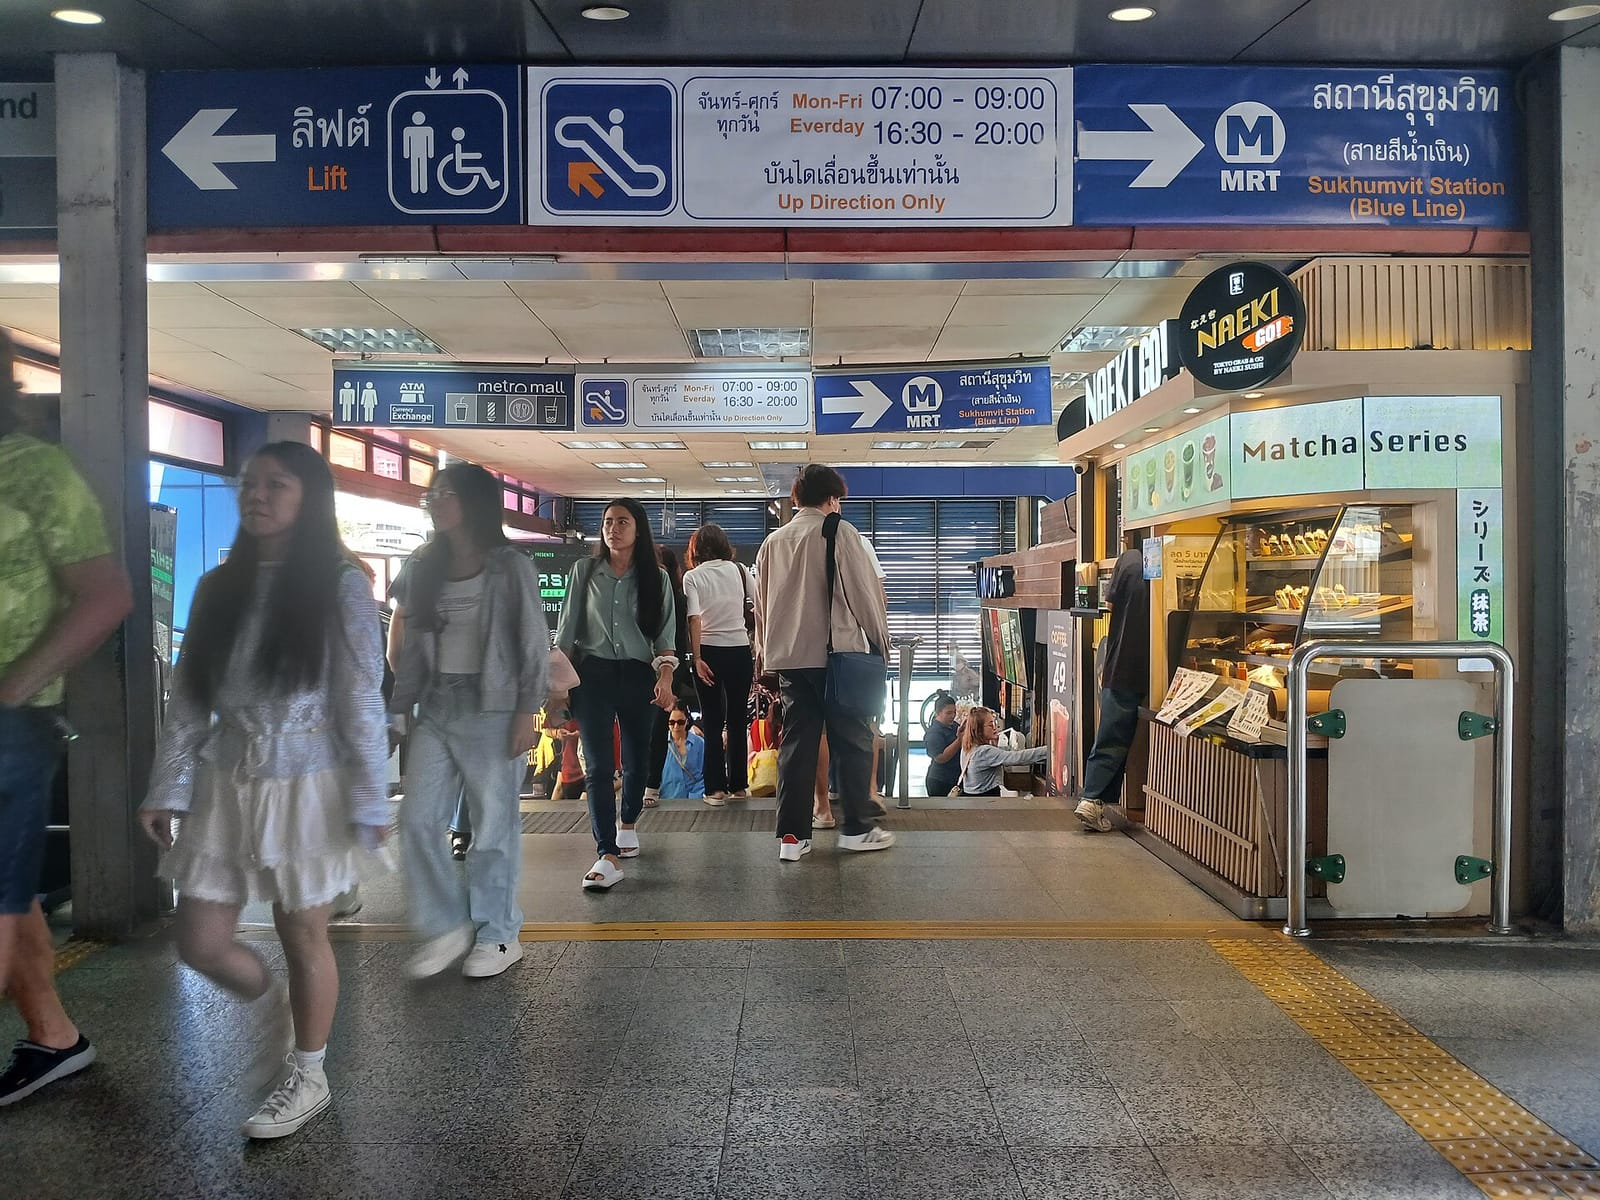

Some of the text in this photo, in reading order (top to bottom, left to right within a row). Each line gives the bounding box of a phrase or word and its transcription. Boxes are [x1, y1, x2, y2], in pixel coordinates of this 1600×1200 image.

[698, 91, 779, 114] จันทร์-ศุกร์
[792, 93, 863, 109] Mon-Fri
[871, 86, 942, 111] 07:00
[974, 86, 1045, 111] 09:00
[1313, 74, 1499, 126] สถานีสุขุมวิท
[292, 103, 372, 148] ลิฟต์
[716, 115, 760, 139] ทุกวัน
[790, 119, 865, 136] Everday
[873, 121, 942, 145] 16:30
[974, 121, 1045, 145] 20:00
[1343, 131, 1470, 167] (สายสีน้ำเงิน)
[308, 166, 348, 191] Lift
[764, 154, 960, 185] บันไดเลื่อนขึ้นเท่านั้น
[1221, 170, 1281, 191] MRT
[1308, 176, 1505, 196] Sukhumvit Station
[778, 194, 946, 212] Up Direction Only
[1350, 199, 1466, 221] (Blue Line)
[1197, 287, 1280, 357] NAEKI
[1255, 320, 1282, 348] GO!
[1085, 319, 1168, 428] NAEKI GO!
[1213, 361, 1232, 369] TOKYO
[1224, 365, 1243, 373] NAEKI
[1244, 362, 1264, 370] SUSHI
[400, 382, 425, 391] ATM
[477, 380, 565, 393] metro mall
[683, 384, 715, 392] Mon-Fri
[722, 381, 753, 392] 07:00
[766, 381, 798, 392] 09:00
[960, 371, 1032, 391] สถานีสุขุมวิท
[683, 395, 716, 405] Everday
[723, 396, 753, 407] 16:30
[766, 396, 798, 407] 20:00
[392, 412, 432, 422] Exchange
[723, 414, 783, 423] Up Direction Only
[906, 414, 940, 428] MRT
[959, 408, 1035, 418] Sukhumvit Station
[974, 417, 1020, 426] (Blue Line)
[1243, 430, 1467, 463] Matcha Series
[1471, 500, 1490, 632] シリーズ 抹茶
